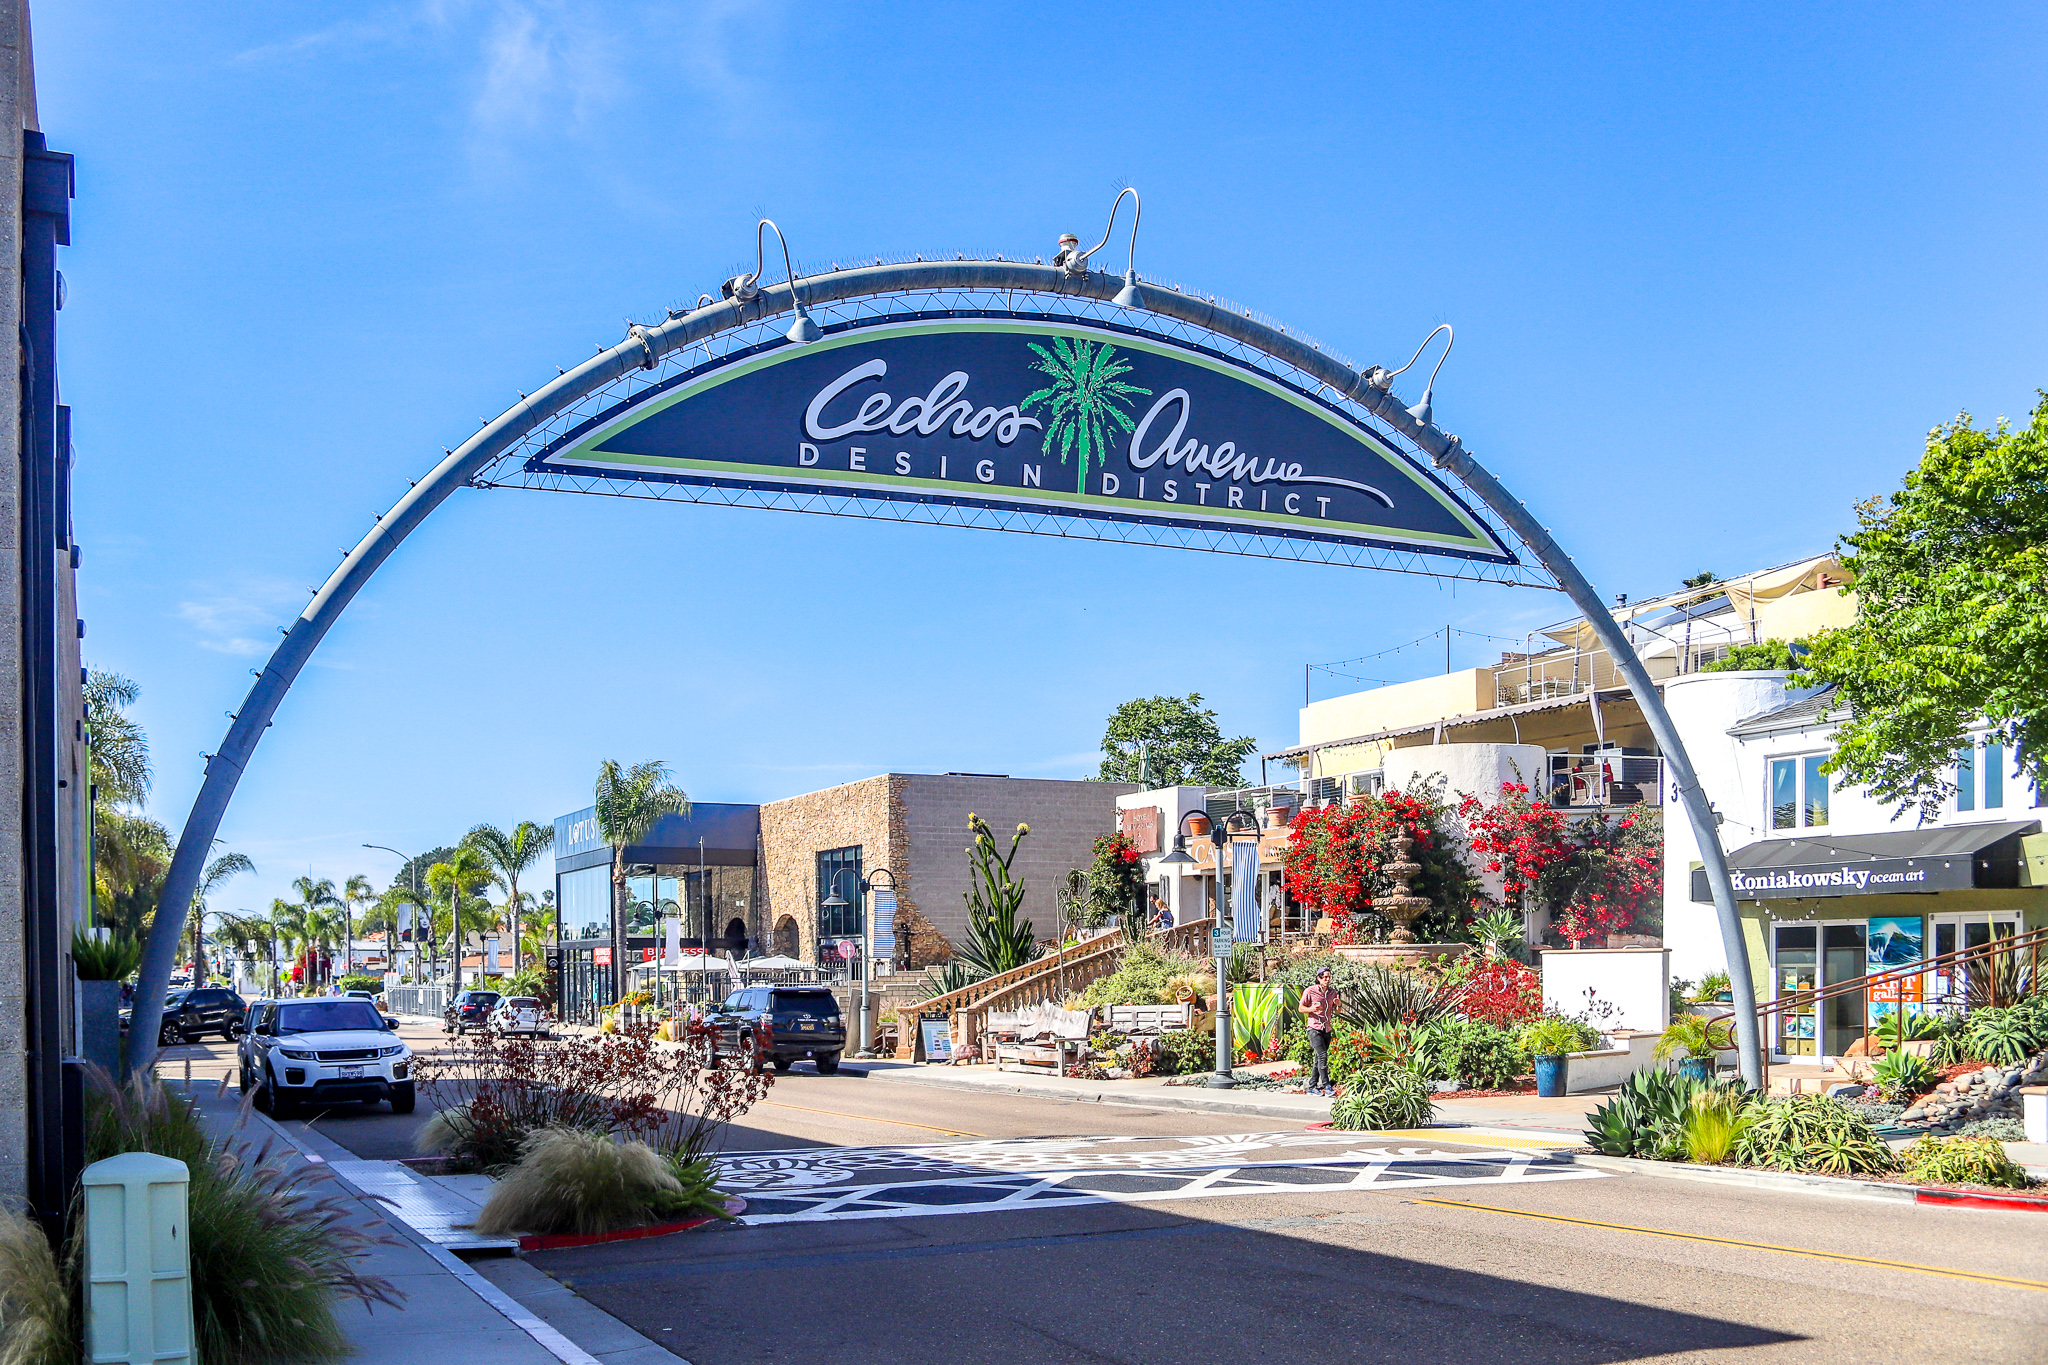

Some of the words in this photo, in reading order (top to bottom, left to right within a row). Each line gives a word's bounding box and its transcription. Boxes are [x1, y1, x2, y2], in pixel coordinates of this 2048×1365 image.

[805, 358, 1042, 444] Cedros
[1129, 388, 1394, 508] Avenue
[799, 442, 1041, 487] DESIGN
[1103, 473, 1331, 518] DISTRICT
[568, 817, 595, 845] LOTUS
[1729, 867, 1871, 891] Koniakowsky
[1870, 872, 1905, 883] ocean
[1906, 869, 1925, 882] art
